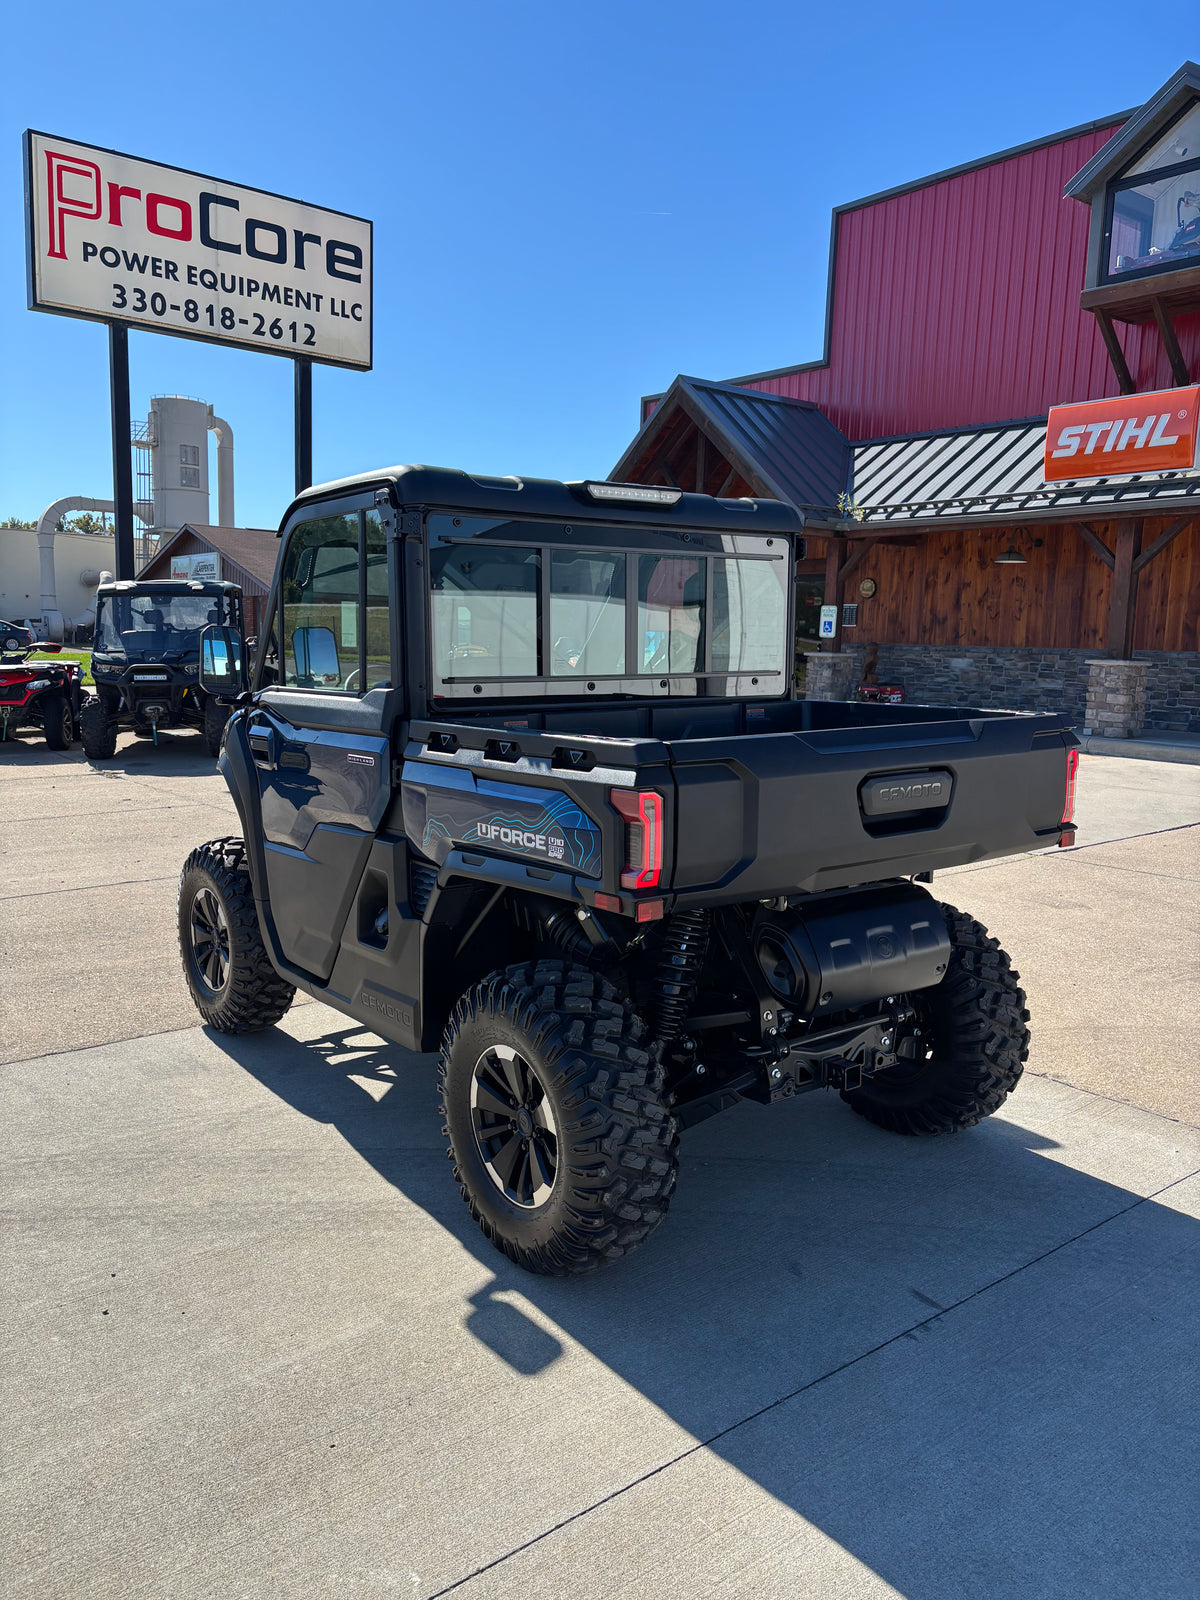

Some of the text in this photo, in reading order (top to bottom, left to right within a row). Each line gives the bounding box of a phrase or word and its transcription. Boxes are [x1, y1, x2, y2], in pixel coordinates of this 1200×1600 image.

[44, 150, 363, 283] ProCore
[82, 241, 363, 322] POWER EQUIPMENT LLC
[112, 284, 317, 346] 330-818-2612
[1051, 413, 1179, 458] STIHL
[880, 782, 942, 800] CFMOTO
[477, 822, 547, 851] UFORCE
